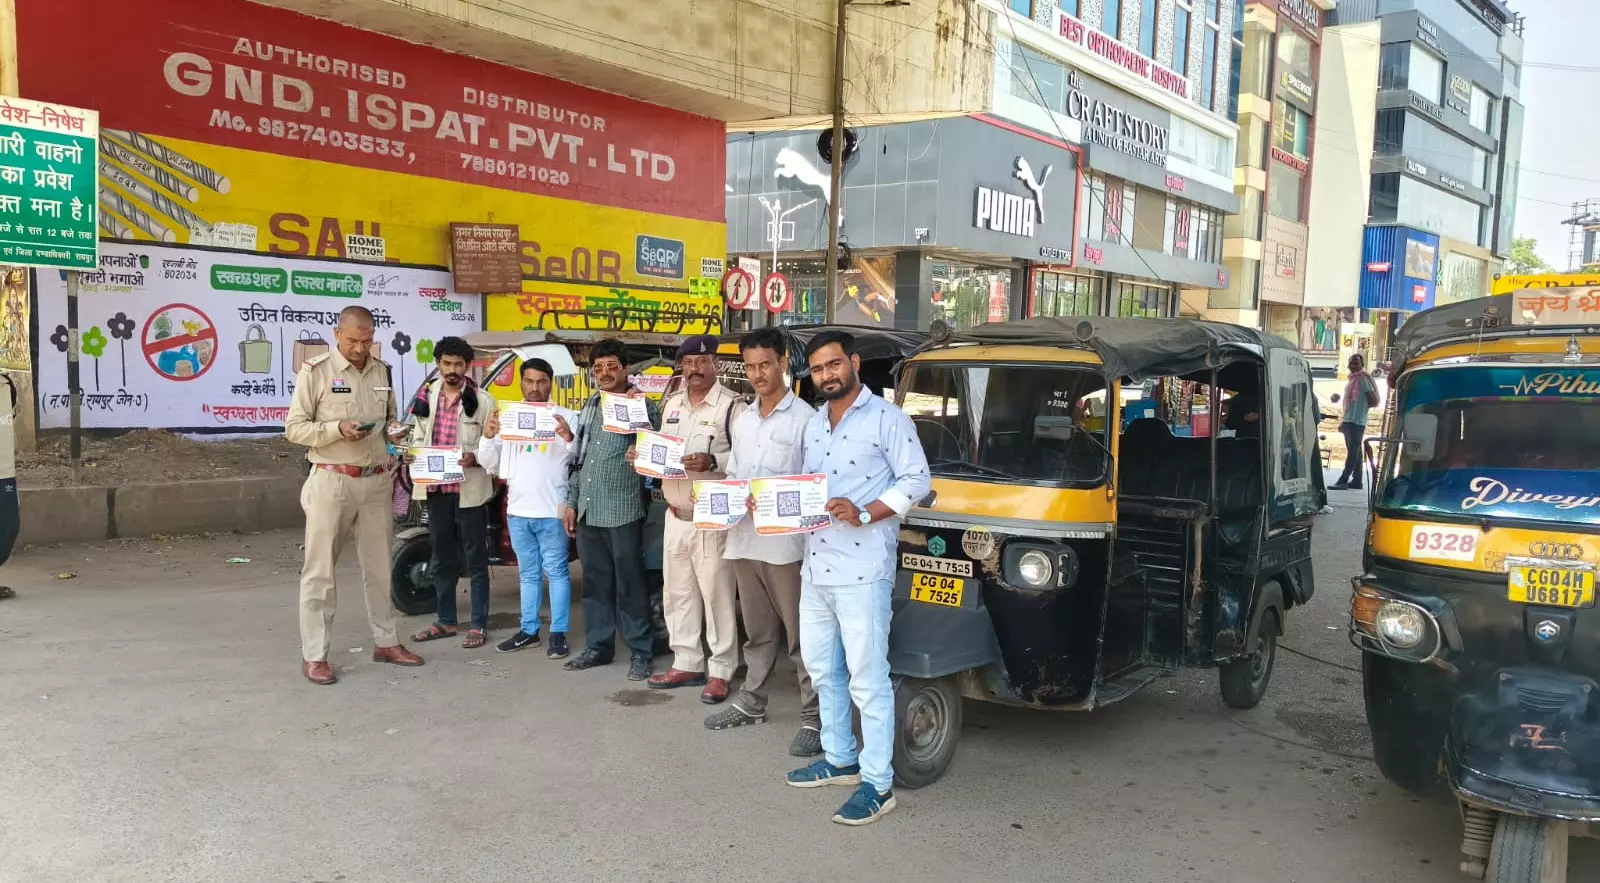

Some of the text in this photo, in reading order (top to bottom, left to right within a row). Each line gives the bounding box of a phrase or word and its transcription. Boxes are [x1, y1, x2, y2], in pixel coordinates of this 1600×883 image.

[232, 37, 406, 89] AUTHORISED
[1060, 14, 1187, 98] BEST ORTHOPAEDIC HOSPITAL
[1069, 70, 1083, 89] the
[463, 86, 606, 132] DISTRIBUTOR
[1068, 89, 1169, 151] CRAFT STORY
[258, 117, 416, 165] 9827403533,
[1092, 128, 1113, 148] UNIT
[1149, 150, 1167, 168] ARTS
[33, 139, 83, 165] वाहनो
[33, 164, 75, 191] प्रवेश
[460, 153, 570, 187] 7880121020
[29, 197, 63, 218] मना
[976, 186, 1035, 238] PUMA
[16, 223, 24, 234] से
[27, 226, 42, 236] रात
[47, 228, 57, 237] 12
[60, 227, 74, 239] बजे
[78, 231, 93, 240] तक
[348, 235, 382, 248] HOME
[473, 225, 491, 239] निगम
[75, 253, 94, 264] रायपुर
[347, 245, 384, 257] TUTION
[519, 240, 622, 284] SeQR
[702, 258, 722, 267] HOME
[110, 271, 144, 287] भगाओ
[164, 270, 197, 281] 802034
[252, 271, 281, 288] शहर
[294, 275, 363, 293] स्वस्थ नागरिक
[238, 303, 278, 325] उचित
[281, 305, 324, 326] विकल्प
[1518, 296, 1571, 316] जय
[966, 530, 990, 541] 1070
[1415, 532, 1475, 553] 9328
[903, 556, 971, 574] CG 04 T 7525
[920, 575, 955, 591] CG 04
[1527, 569, 1584, 589] CG04M
[914, 587, 958, 605] T 7525
[1526, 585, 1583, 606] U6817
